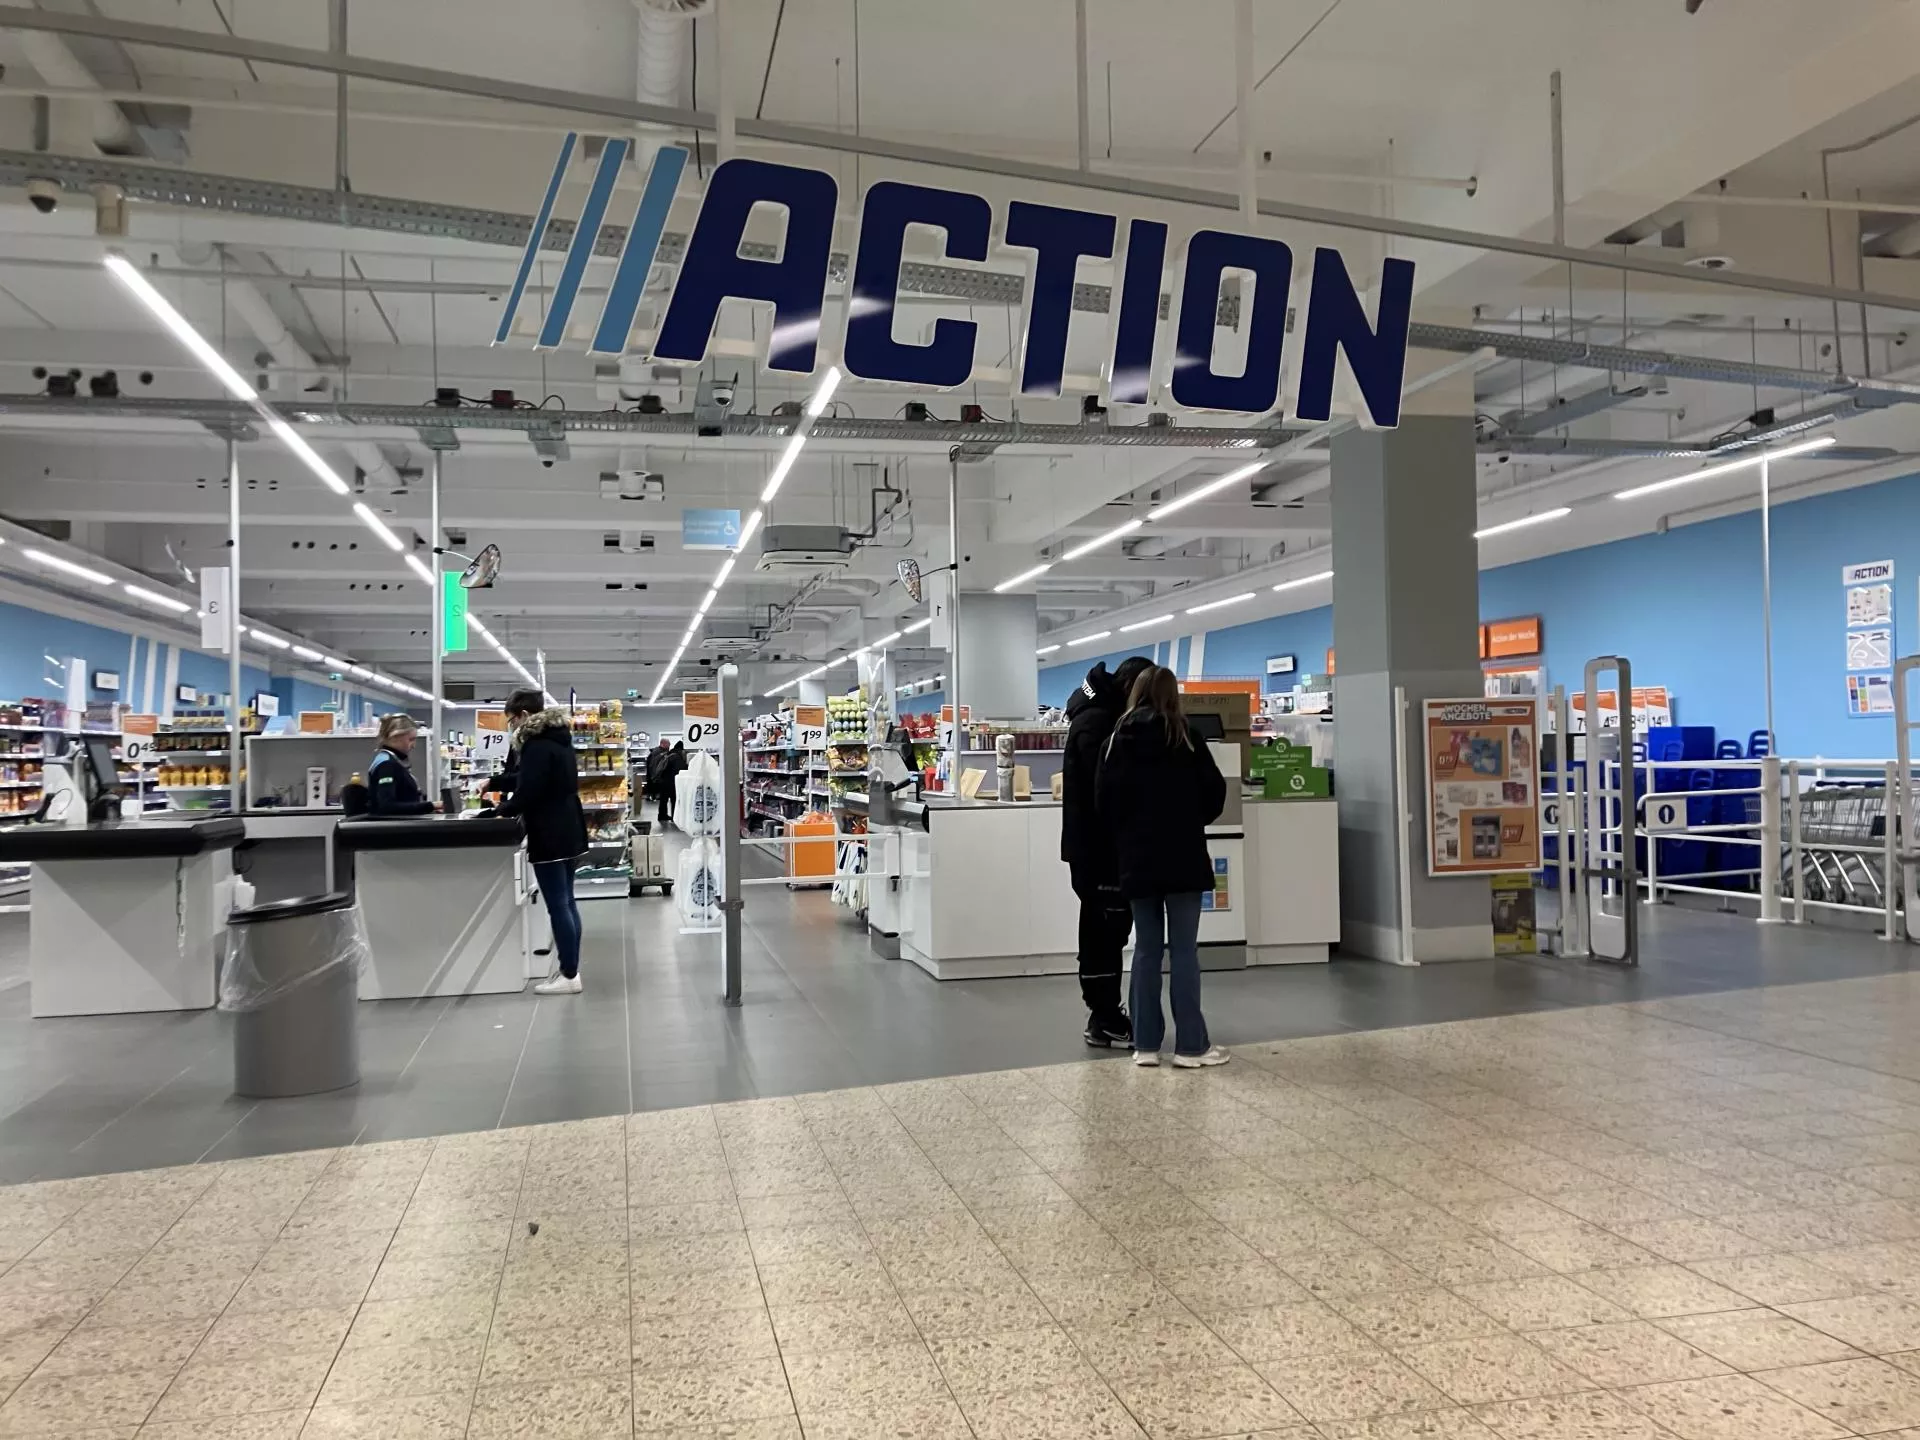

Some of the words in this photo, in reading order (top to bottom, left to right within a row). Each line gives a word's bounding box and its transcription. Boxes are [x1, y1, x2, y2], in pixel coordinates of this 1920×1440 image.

[652, 157, 1417, 431] ACTION
[1854, 565, 1889, 580] ACTION
[1444, 703, 1486, 713] WOCHEN
[1440, 711, 1492, 721] ANGEBOTE
